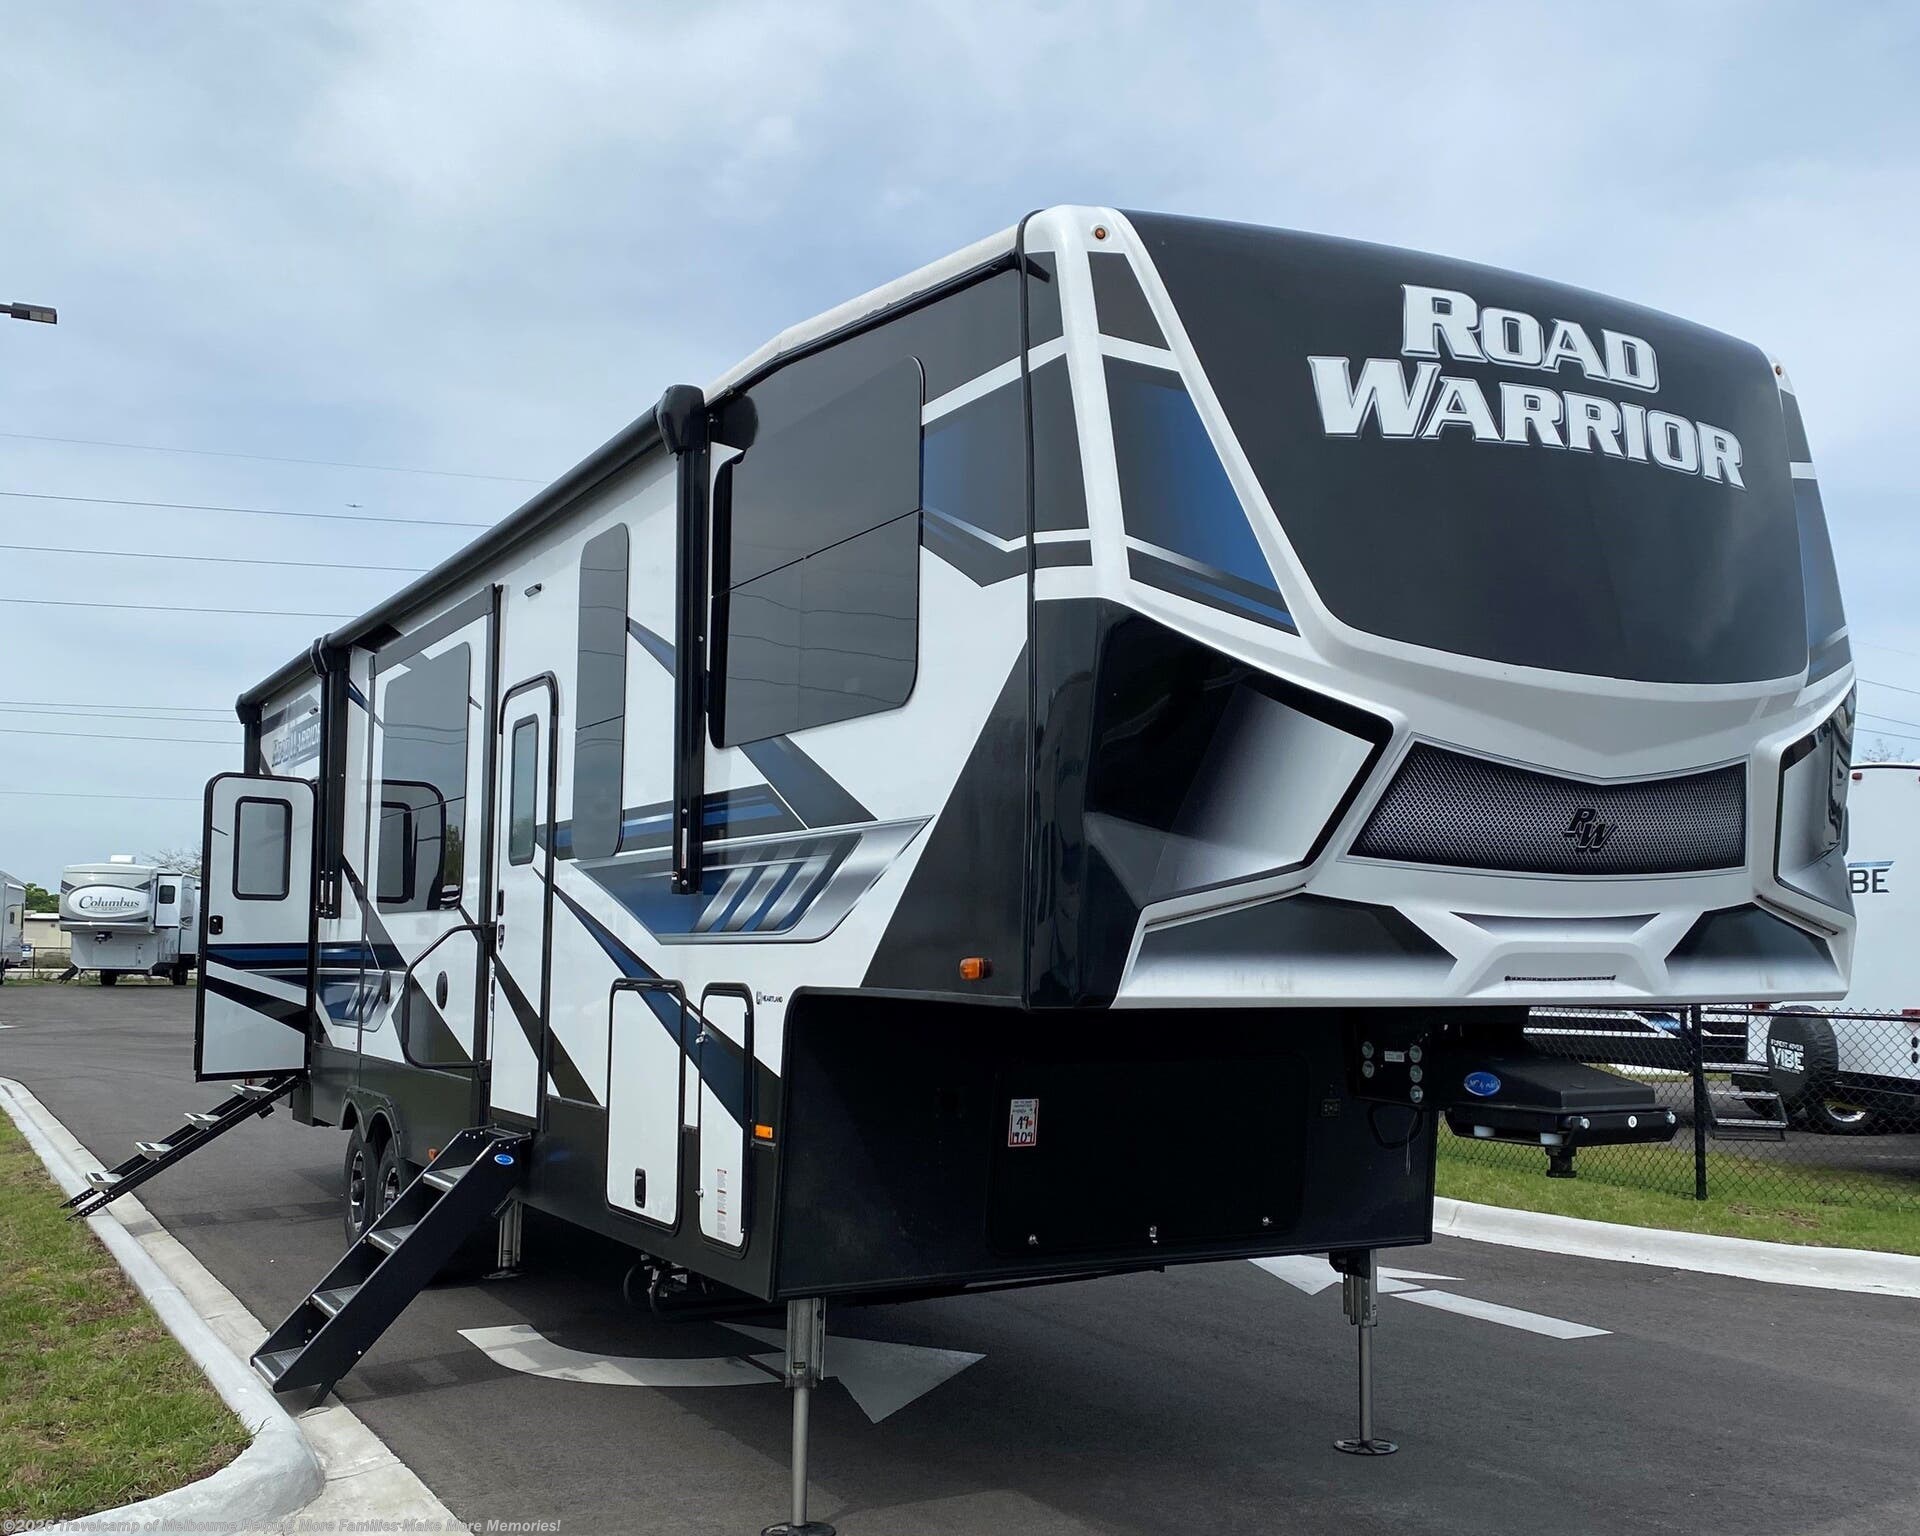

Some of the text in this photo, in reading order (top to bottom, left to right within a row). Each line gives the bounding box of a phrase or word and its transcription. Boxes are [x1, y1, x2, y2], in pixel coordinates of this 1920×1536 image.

[1401, 284, 1659, 393] ROAD
[1307, 356, 1747, 490] WARRIOR
[79, 895, 140, 909] Columbus
[1771, 1046, 1805, 1071] VIBE
